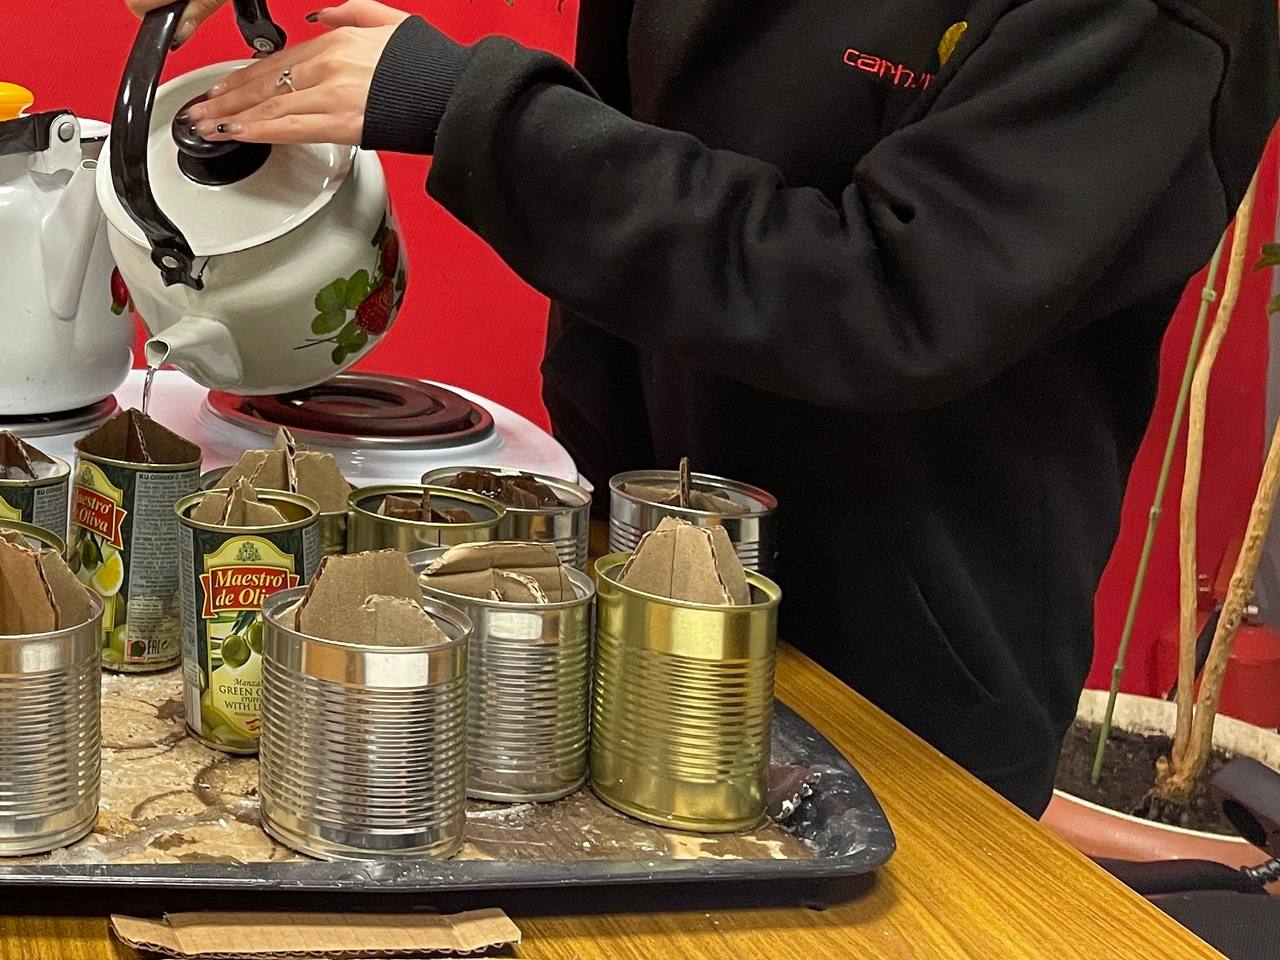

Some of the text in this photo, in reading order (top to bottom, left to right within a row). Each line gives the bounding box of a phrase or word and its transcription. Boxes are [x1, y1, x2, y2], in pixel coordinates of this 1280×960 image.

[843, 48, 935, 90] carh
[79, 506, 109, 532] Oliva
[214, 570, 283, 588] Maestro
[215, 588, 270, 606] de Oli
[218, 684, 253, 697] GREEN
[224, 700, 250, 711] WITH
